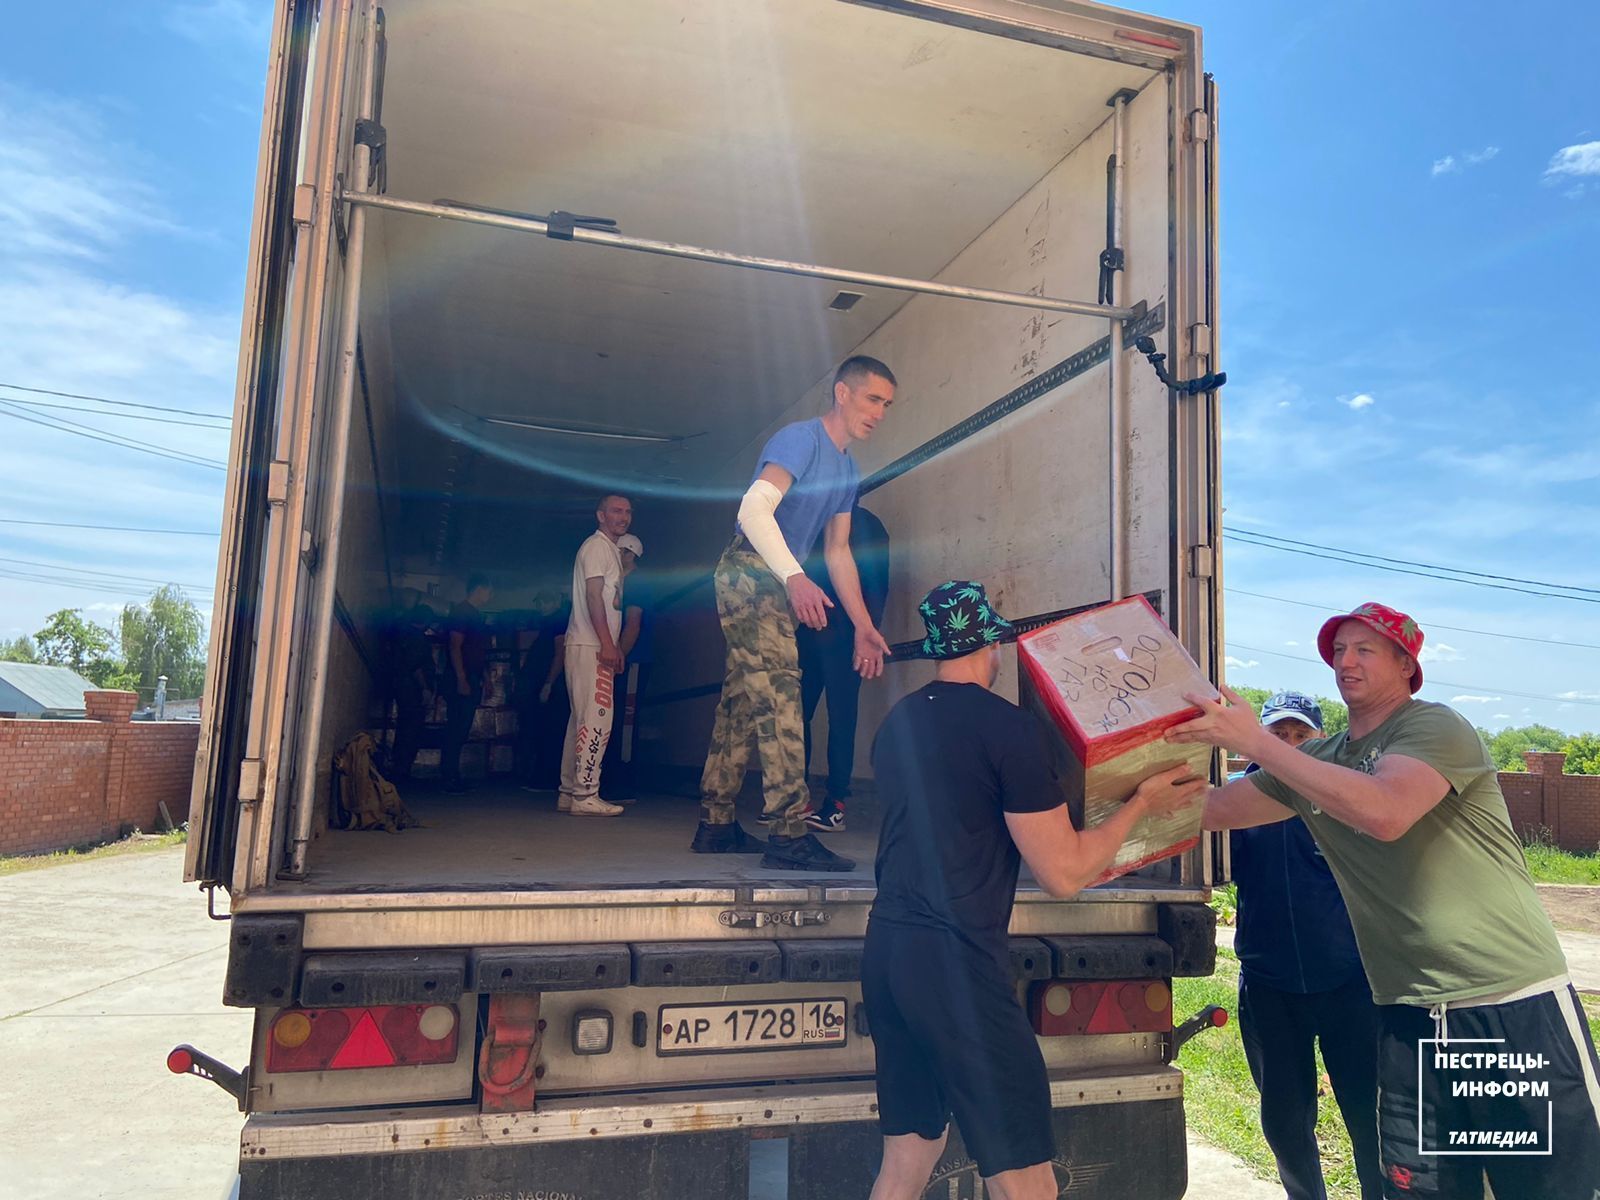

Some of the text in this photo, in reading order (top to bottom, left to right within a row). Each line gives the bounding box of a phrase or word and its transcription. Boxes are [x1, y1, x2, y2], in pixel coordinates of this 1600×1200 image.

[724, 1008, 796, 1041] 1728
[809, 1003, 836, 1028] 16
[803, 1029, 825, 1039] RUS
